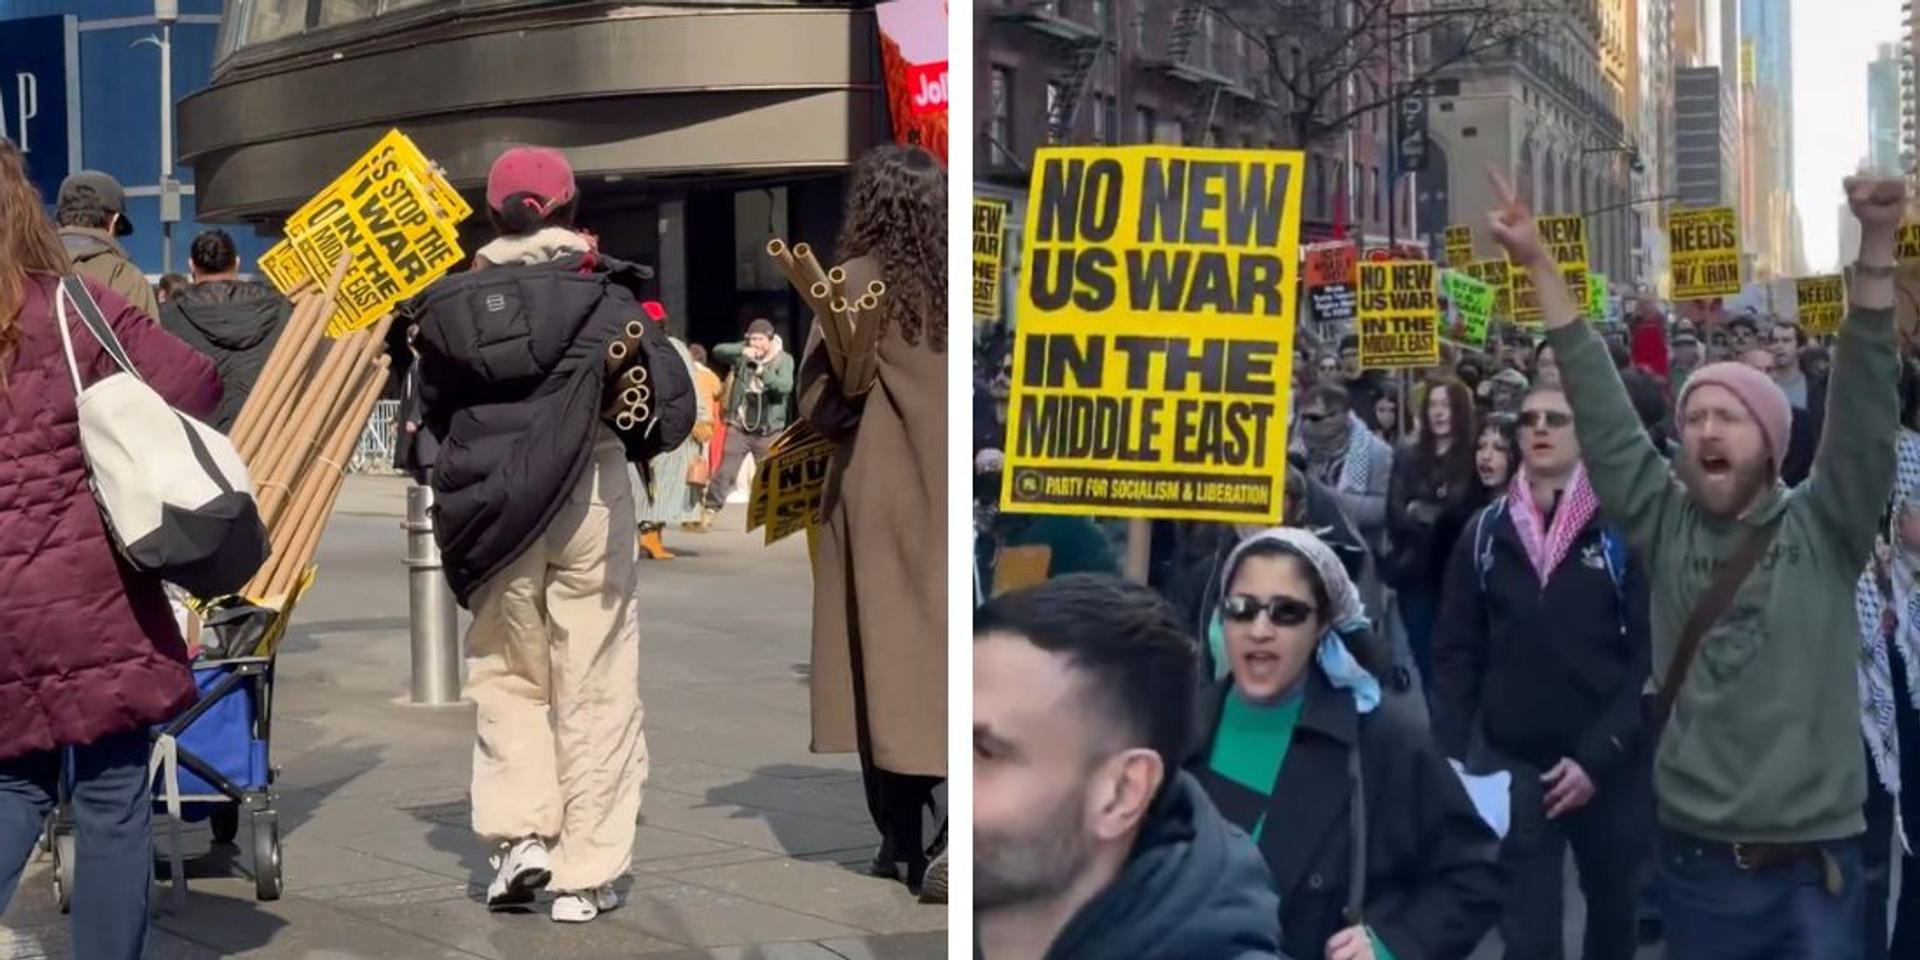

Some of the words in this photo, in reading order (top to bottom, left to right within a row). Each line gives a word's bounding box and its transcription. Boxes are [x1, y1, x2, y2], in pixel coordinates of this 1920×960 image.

[915, 71, 948, 106] Jol
[1036, 157, 1123, 242] NO
[1137, 156, 1291, 247] NEW
[359, 193, 428, 285] WAR
[382, 178, 427, 232] STOP
[415, 225, 454, 268] THE
[1538, 218, 1581, 244] NEW
[1671, 223, 1735, 253] NEEDS
[333, 213, 364, 247] IN
[356, 244, 400, 300] THE
[1701, 264, 1738, 284] IRAN
[346, 275, 383, 312] EAST
[1030, 247, 1118, 312] US
[1125, 250, 1284, 316] WAR
[1361, 265, 1386, 291] NO
[1391, 264, 1433, 290] NEW
[1361, 292, 1388, 312] US
[1391, 291, 1433, 310] WAR
[1362, 317, 1386, 334] IN
[1390, 316, 1434, 333] THE
[1364, 334, 1405, 353] MIDDLE
[1408, 333, 1434, 352] EAST
[1023, 334, 1106, 388] IN
[1114, 335, 1279, 396] THE
[1015, 394, 1165, 462] MIDDLE
[1173, 398, 1275, 468] EAST
[1045, 476, 1083, 496] PARTY
[1085, 477, 1108, 498] FOR
[1110, 478, 1179, 501] SOCIALISM
[1182, 481, 1193, 501] &
[1196, 481, 1269, 504] LIBERATION
